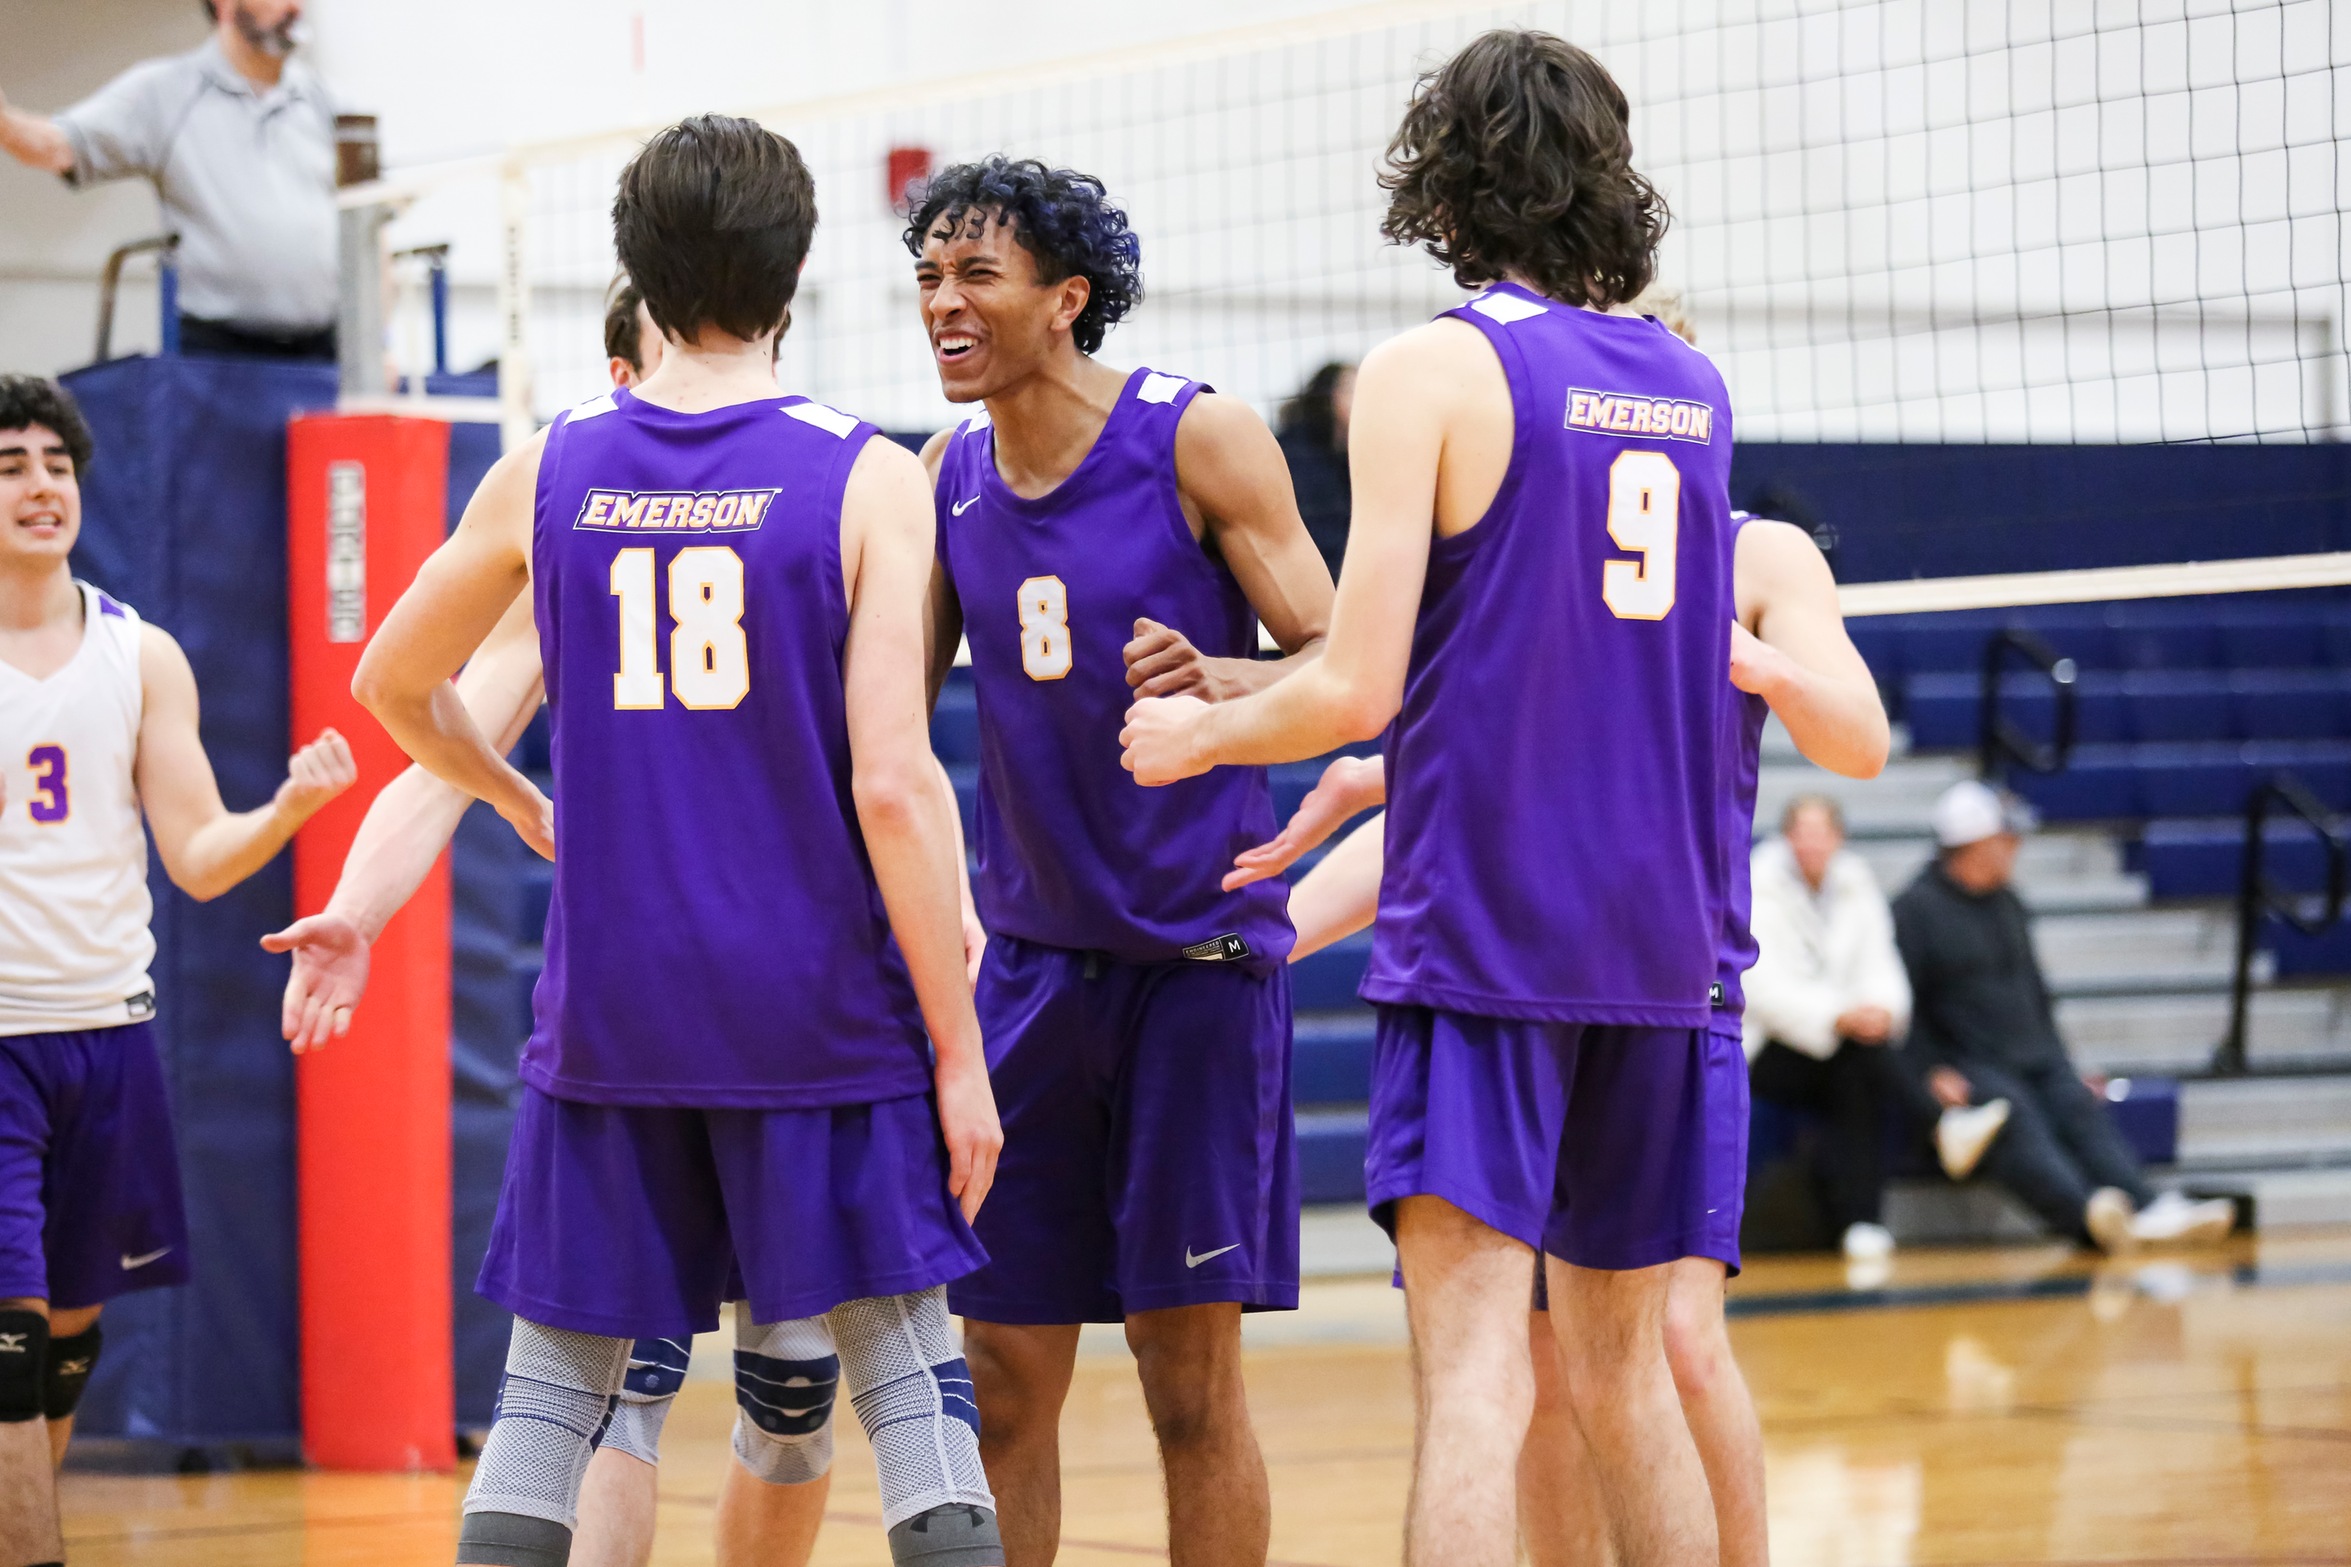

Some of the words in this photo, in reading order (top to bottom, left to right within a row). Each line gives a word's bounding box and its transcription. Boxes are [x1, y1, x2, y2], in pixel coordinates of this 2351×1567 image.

[1568, 392, 1711, 439] EMERSON
[581, 494, 768, 528] EMERSON
[1602, 449, 1680, 621] 9
[610, 546, 750, 711] 18
[1017, 574, 1073, 682] 8
[26, 741, 71, 826] 3
[1185, 940, 1220, 954] ENGINEERED
[1228, 939, 1241, 953] M
